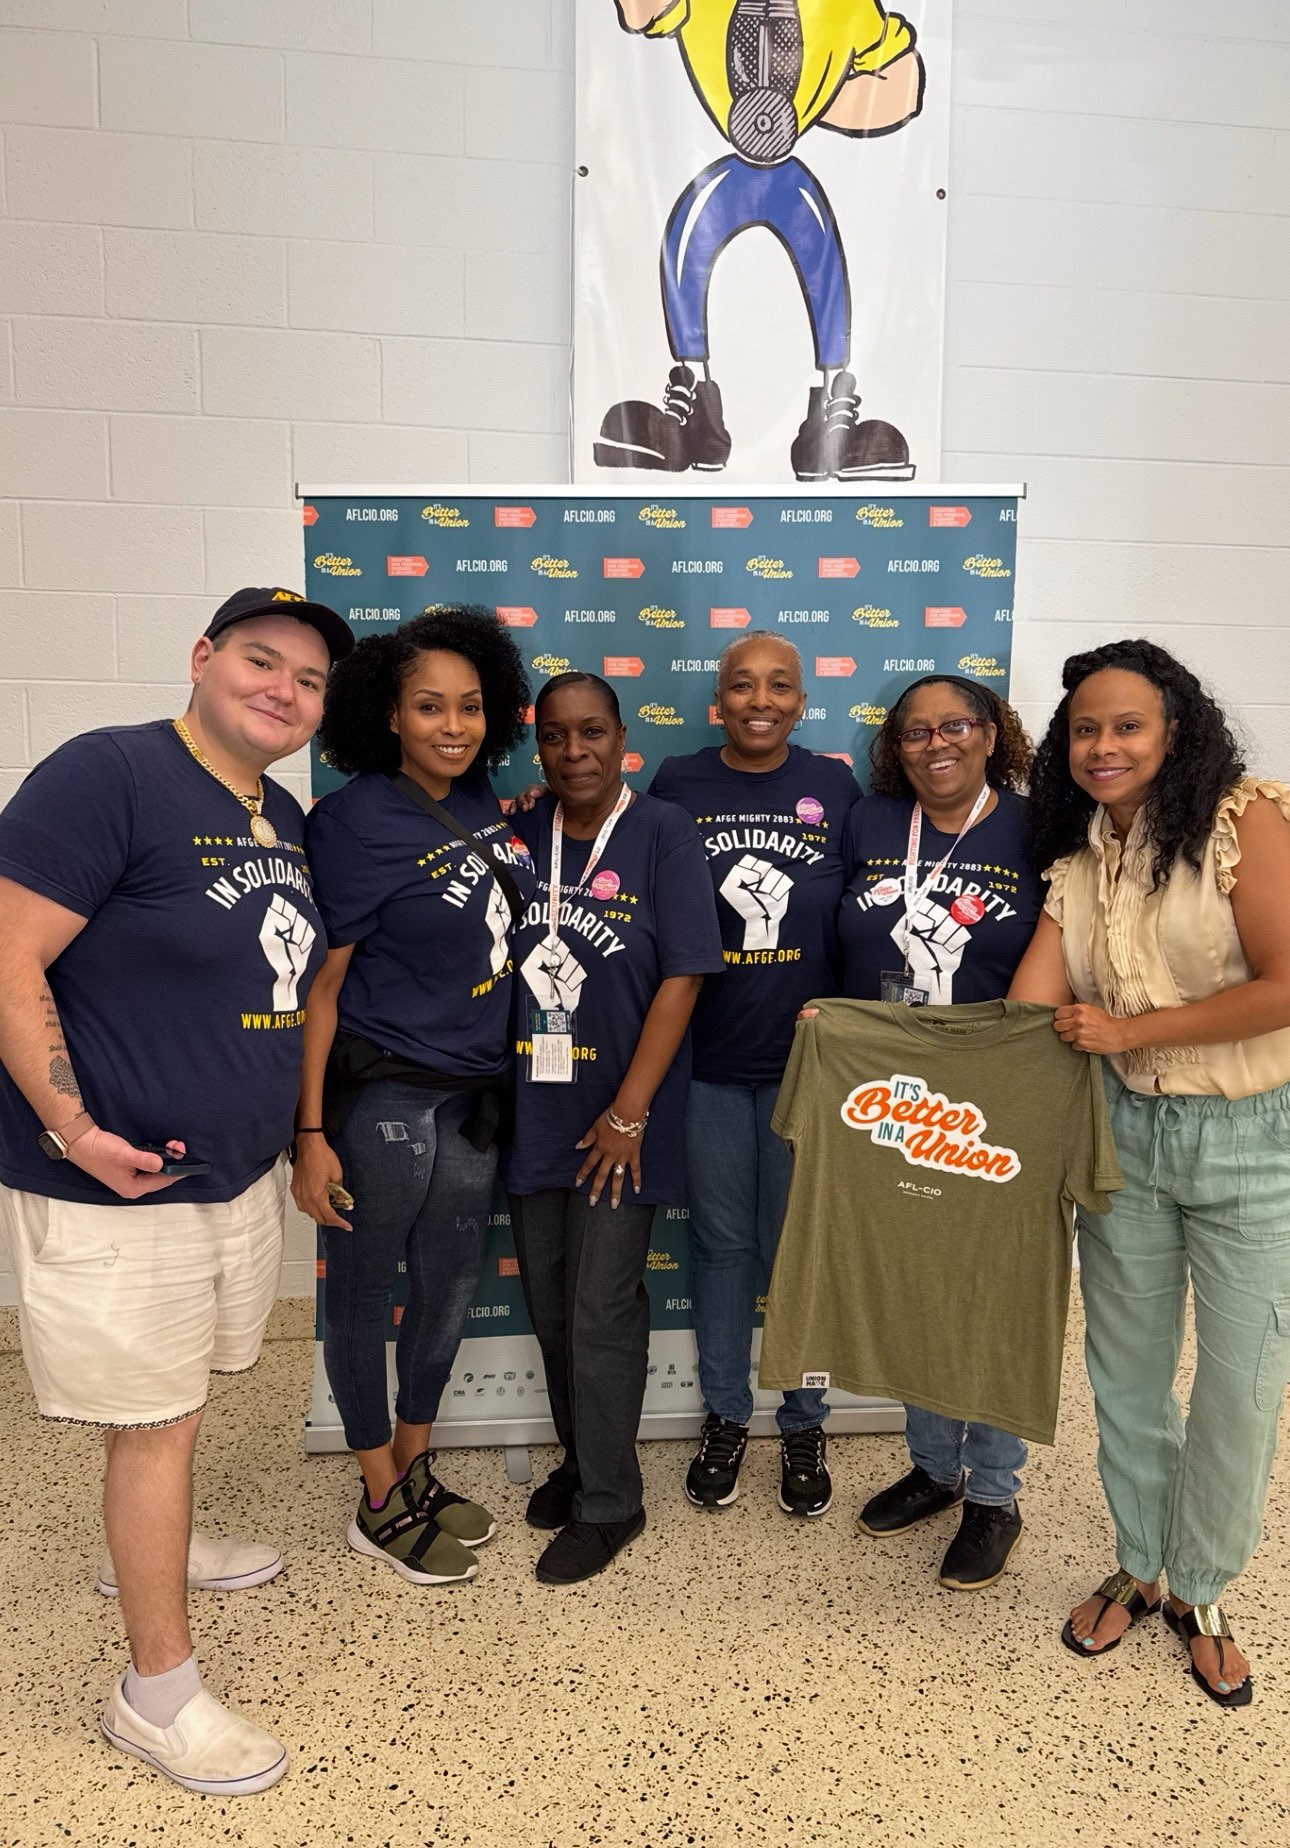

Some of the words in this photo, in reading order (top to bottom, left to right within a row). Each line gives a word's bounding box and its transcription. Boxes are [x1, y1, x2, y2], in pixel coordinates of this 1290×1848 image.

[346, 508, 399, 522] AFLCIO.ORG
[422, 506, 460, 520] Better
[563, 509, 616, 523] AFLCIO.ORG
[638, 507, 678, 520] Better
[780, 509, 833, 523] AFLCIO.ORG
[856, 506, 895, 519] Better
[438, 516, 470, 527] Union
[655, 517, 687, 528] Union
[872, 516, 904, 526] Union
[314, 556, 352, 568] Better
[456, 559, 508, 573] AFLCIO.ORG
[530, 557, 570, 570] Better
[671, 560, 724, 574] AFLCIO.ORG
[746, 558, 786, 571] Better
[887, 560, 940, 573] AFLCIO.ORG
[963, 556, 1002, 570] Better
[330, 566, 362, 576] Union
[547, 567, 579, 578] Union
[763, 568, 795, 578] Union
[980, 566, 1012, 577] Union
[349, 607, 401, 621] AFLCIO.ORG
[565, 610, 616, 623] AFLCIO.ORG
[638, 608, 678, 620] Better
[778, 610, 830, 623] AFLCIO.ORG
[852, 606, 891, 620] Better
[655, 618, 687, 628] Union
[868, 616, 900, 627] Union
[532, 656, 571, 669] Better
[883, 659, 935, 672] AFLCIO.ORG
[958, 656, 996, 669] Better
[974, 666, 1006, 676] Union
[638, 704, 677, 717] Better
[848, 705, 888, 718] Better
[654, 714, 684, 726] Union
[715, 814, 737, 823] AFGE
[739, 814, 771, 823] MIGHTY
[773, 815, 794, 824] 2883
[802, 832, 827, 844] 1972
[704, 828, 825, 866] SOLIDARITY
[201, 857, 231, 867] EST.
[959, 862, 982, 872] 2883
[431, 862, 458, 880] EST.
[205, 876, 242, 910] IN
[441, 880, 472, 909] IN
[603, 910, 632, 923] 1972
[722, 948, 801, 965] WW.AFGE.ORG
[893, 1080, 922, 1102] IT'S
[847, 1086, 980, 1136] Better
[877, 1121, 894, 1140] IN
[894, 1125, 905, 1143] A
[904, 1129, 1014, 1177] Union
[897, 1181, 942, 1196] AFL-CIO
